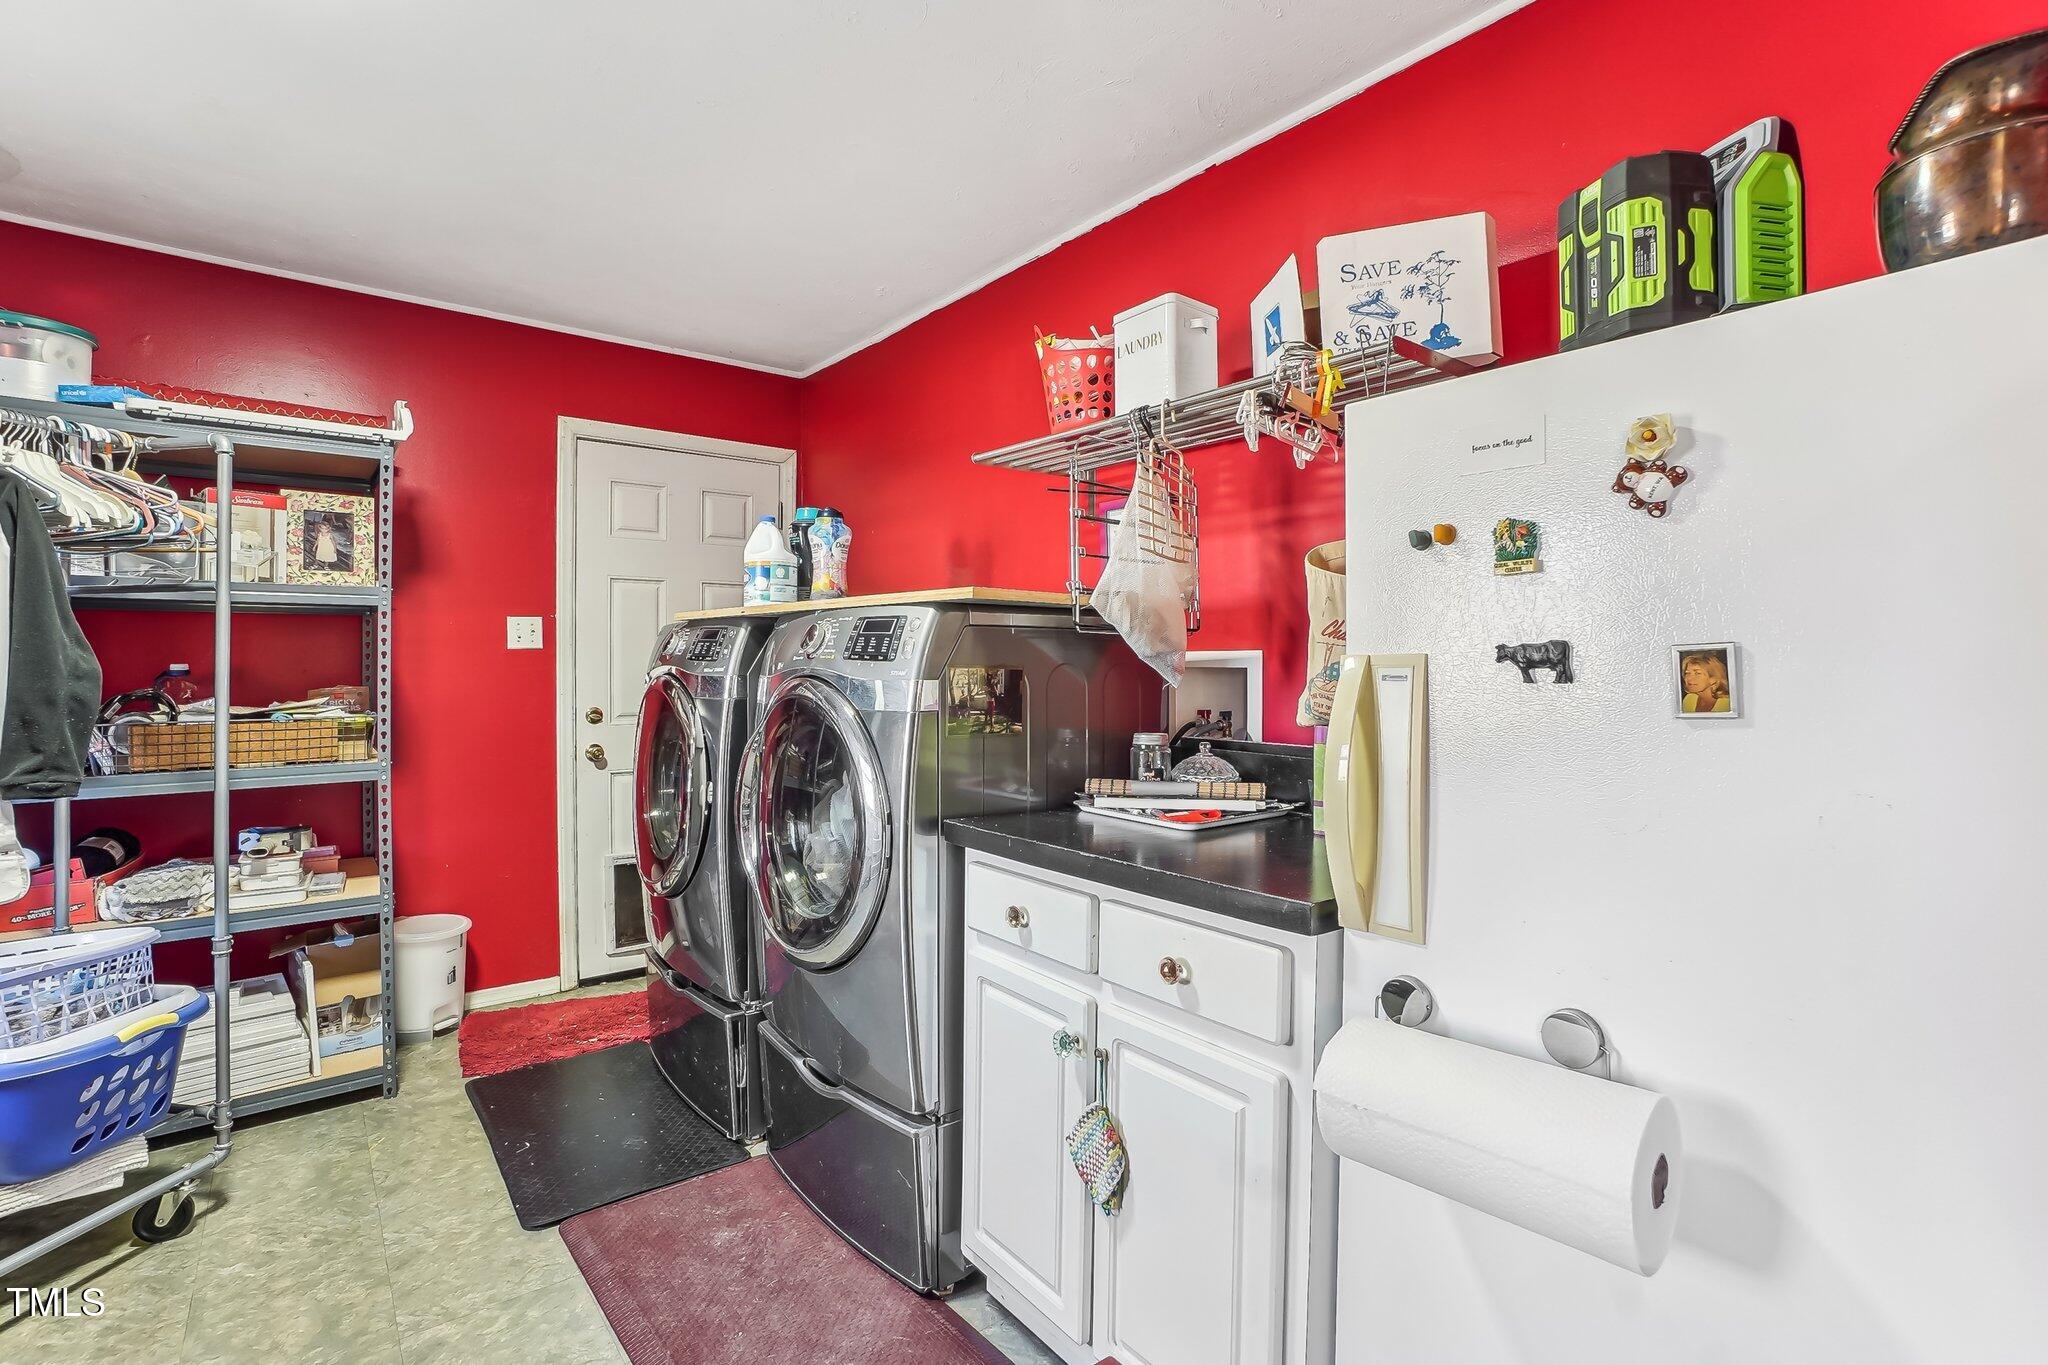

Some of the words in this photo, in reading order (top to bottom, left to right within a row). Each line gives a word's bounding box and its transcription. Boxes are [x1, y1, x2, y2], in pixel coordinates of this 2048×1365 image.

[1340, 260, 1401, 283] SAVE
[1590, 278, 1598, 308] EGO
[1117, 331, 1163, 359] LAUNDRY
[1333, 331, 1350, 347] &
[1355, 321, 1418, 344] SAVE
[1472, 445, 1491, 454] focus
[1502, 439, 1514, 447] the
[1515, 435, 1533, 449] good
[232, 496, 264, 506] Sunbeam
